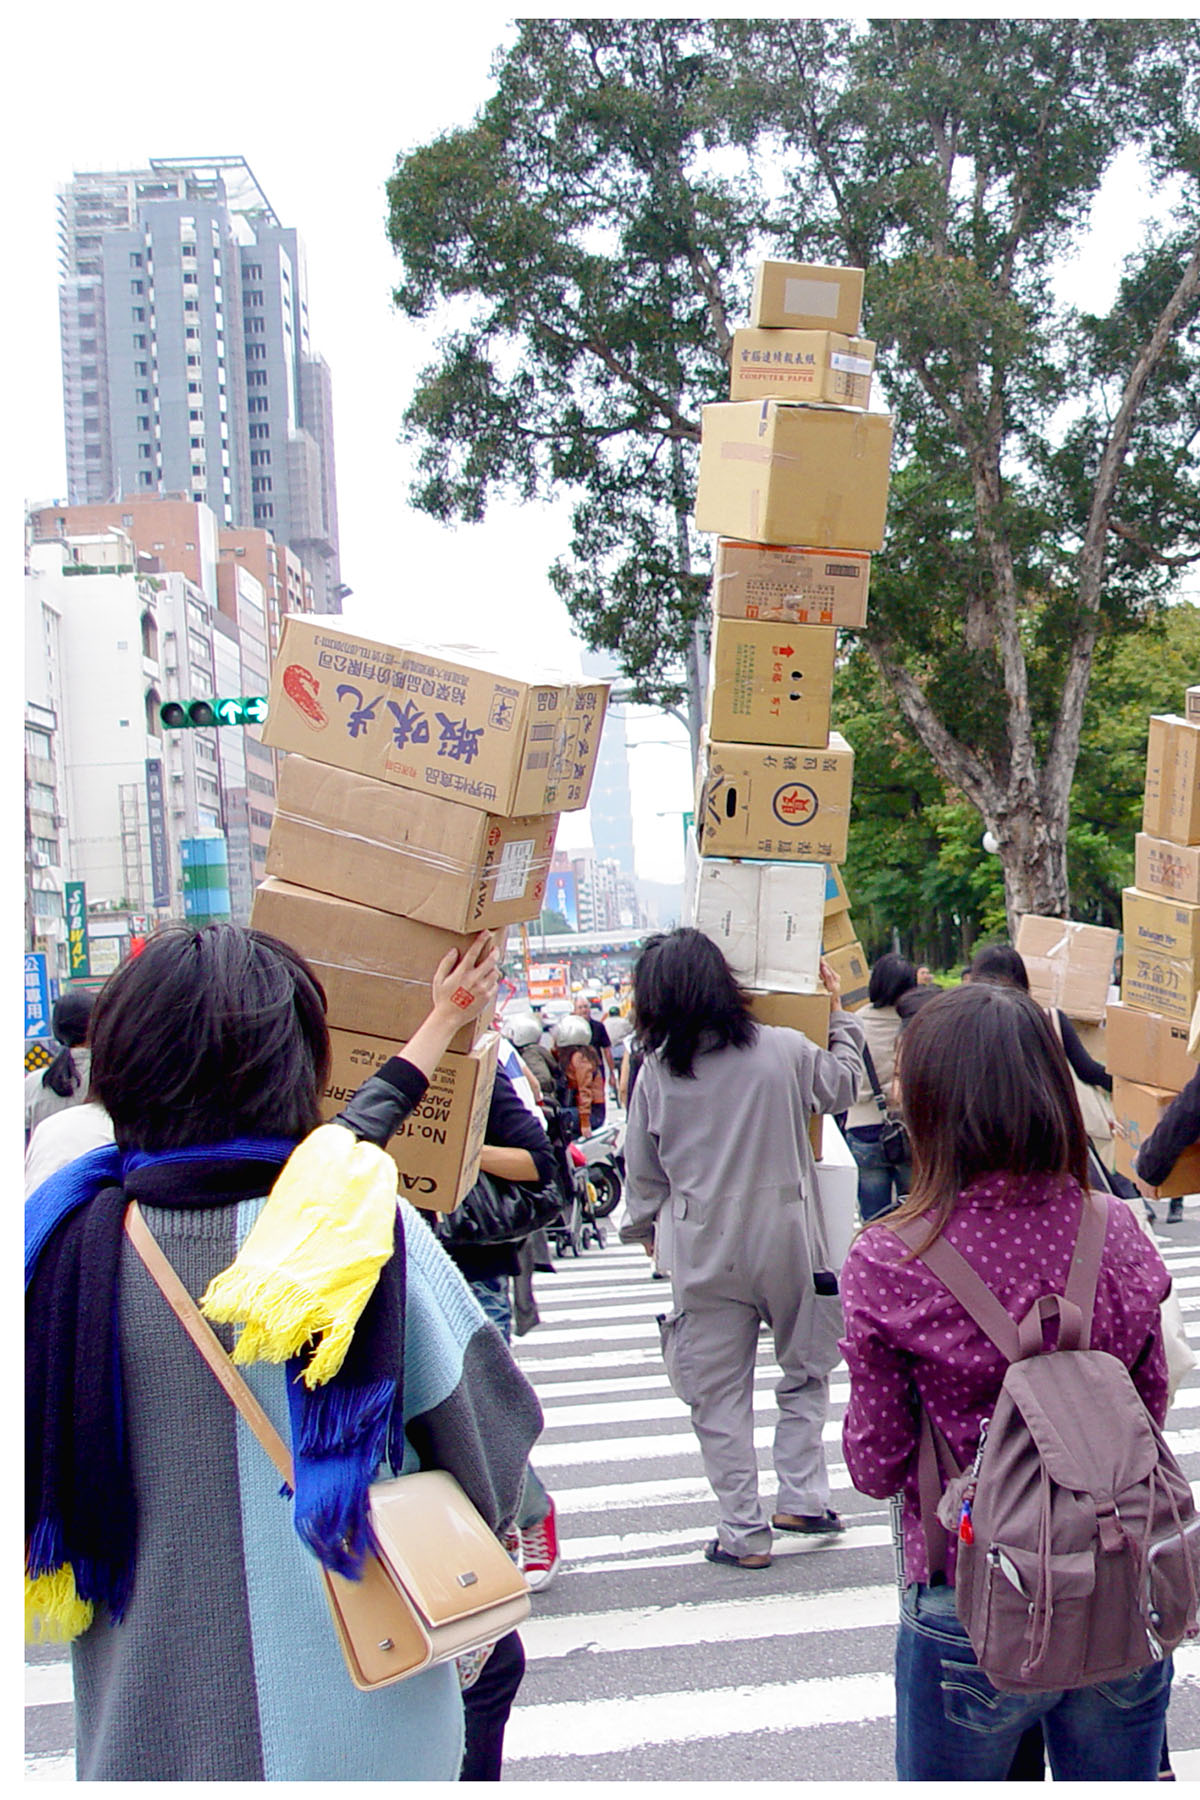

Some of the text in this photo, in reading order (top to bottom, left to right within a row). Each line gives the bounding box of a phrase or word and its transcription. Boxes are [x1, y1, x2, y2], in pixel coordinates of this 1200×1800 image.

[739, 372, 814, 384] COMPUTER PAPER
[335, 684, 486, 765] 蝦味先
[424, 766, 498, 803] 世界性食品
[68, 888, 86, 969] SUBWAY
[420, 1093, 453, 1107] PAPE
[412, 1103, 450, 1122] MOS
[398, 1171, 438, 1194] CA
